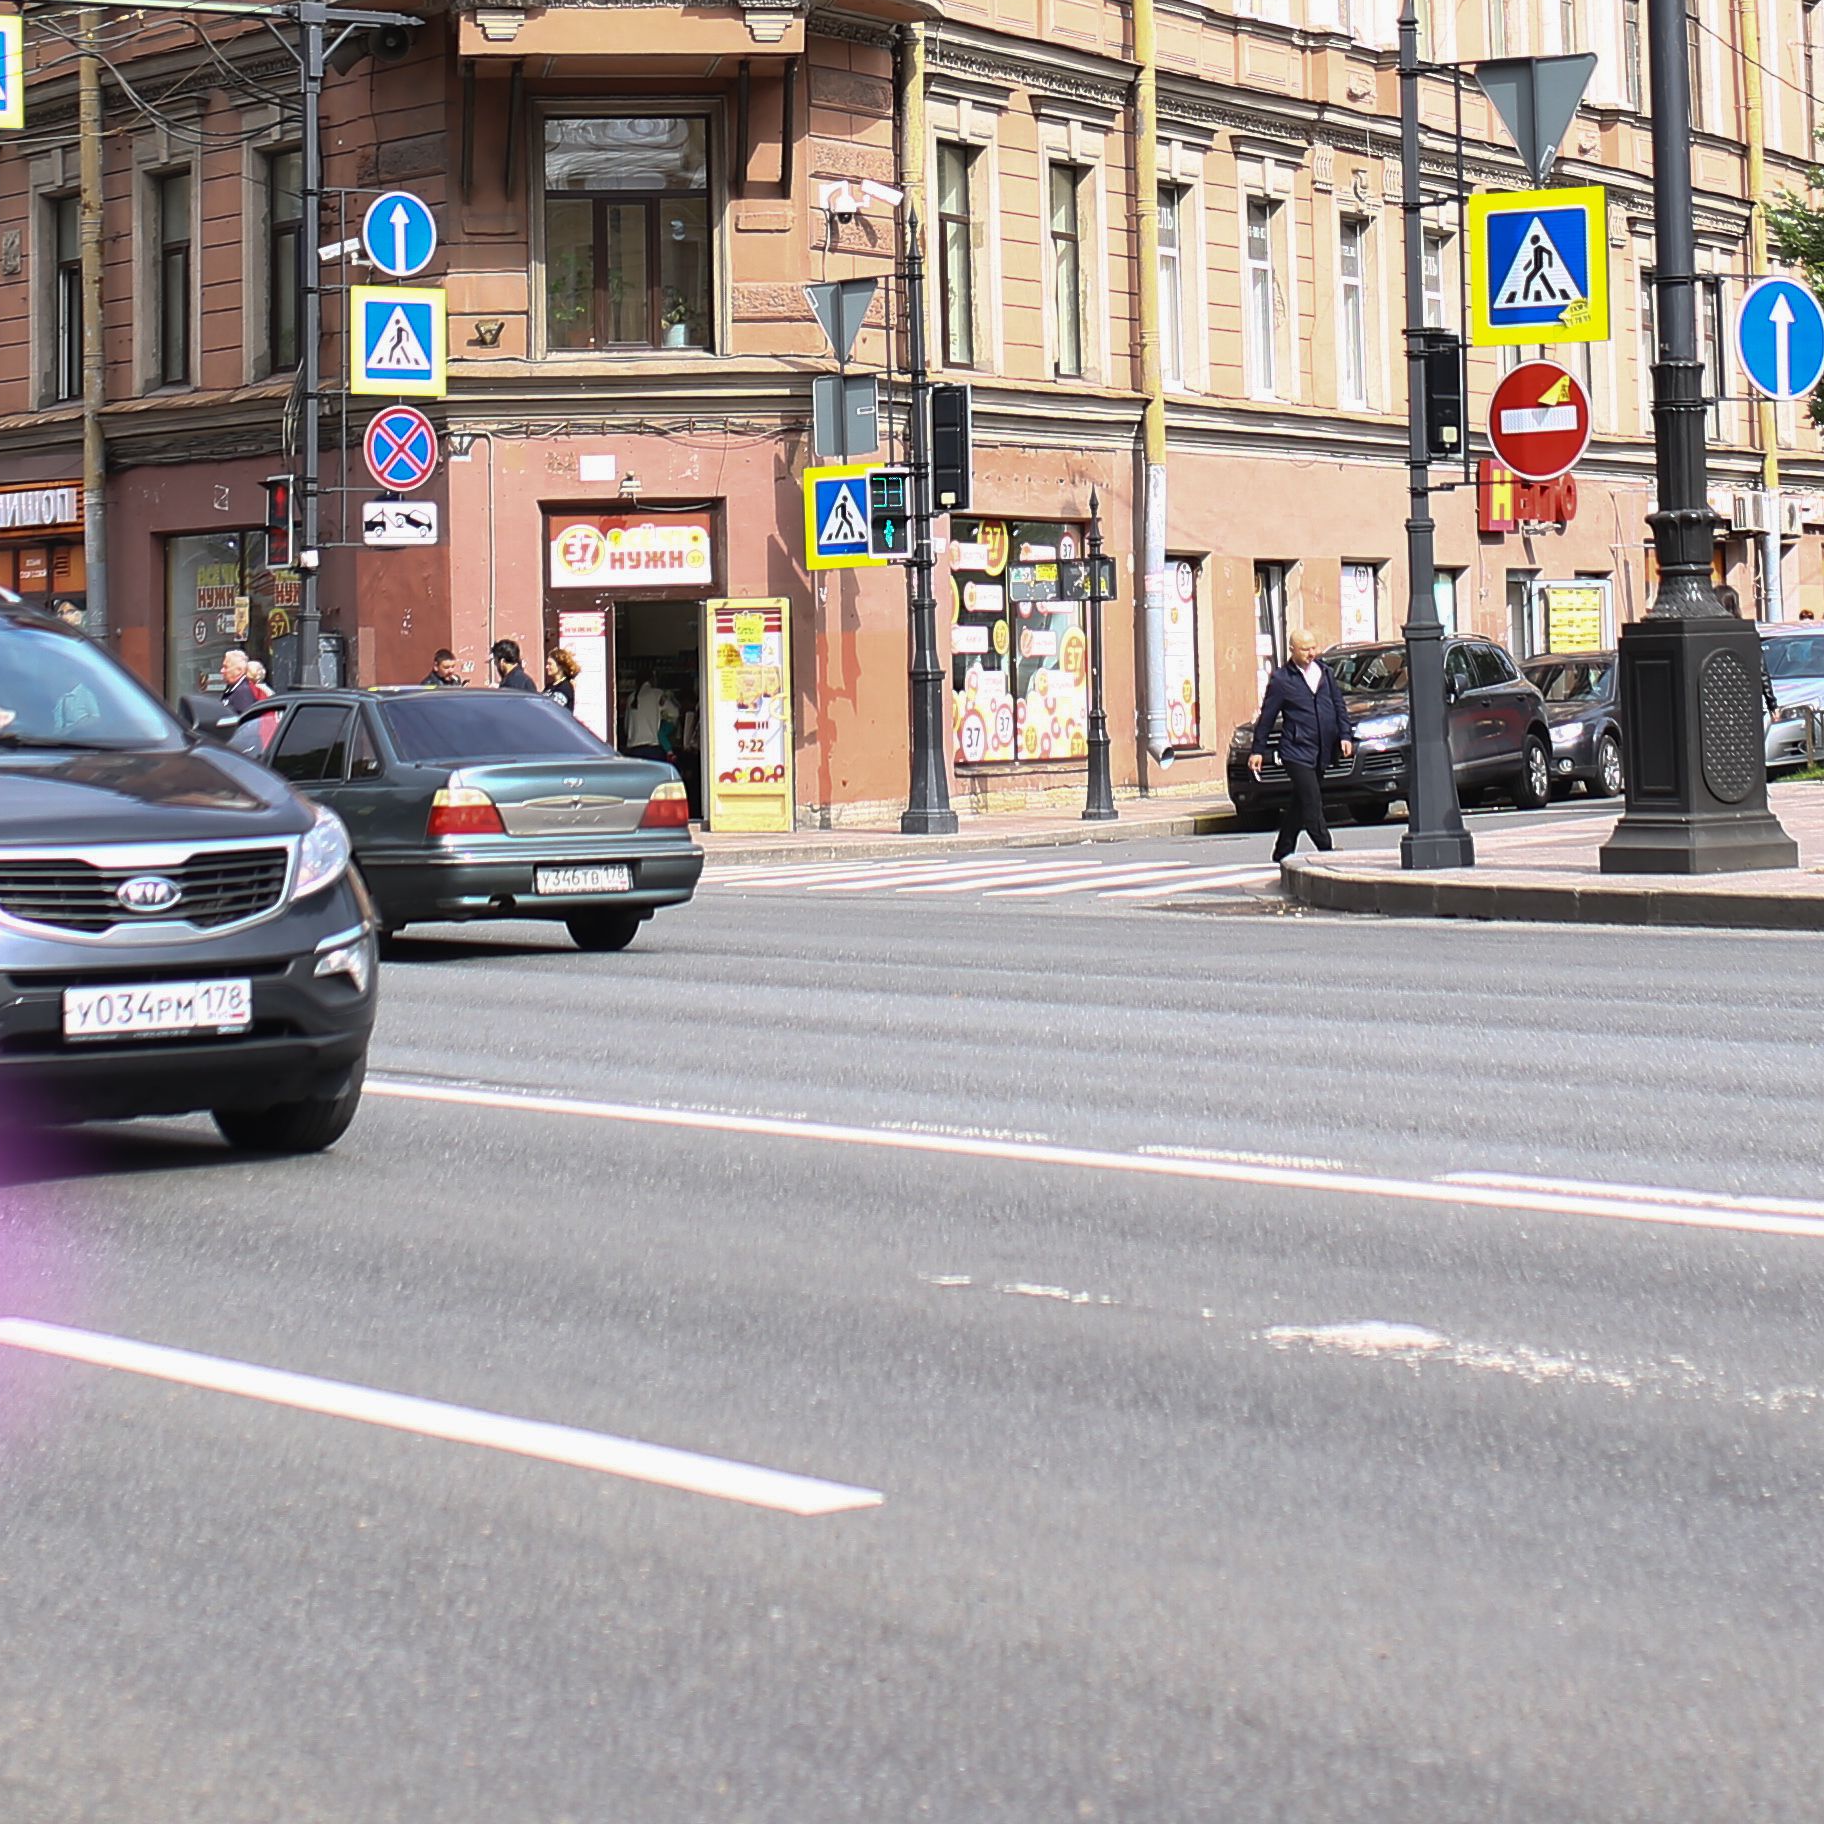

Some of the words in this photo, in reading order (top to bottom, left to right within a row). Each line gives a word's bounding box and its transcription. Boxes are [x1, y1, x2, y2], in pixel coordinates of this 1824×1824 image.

[872, 477, 903, 508] 33
[565, 536, 599, 563] 37
[1063, 543, 1073, 558] 37
[1066, 648, 1083, 672] 37
[999, 717, 1010, 732] 37
[737, 739, 765, 753] 9-22
[966, 727, 981, 748] 37
[77, 992, 195, 1028] У034РМ
[201, 987, 243, 1013] 178
